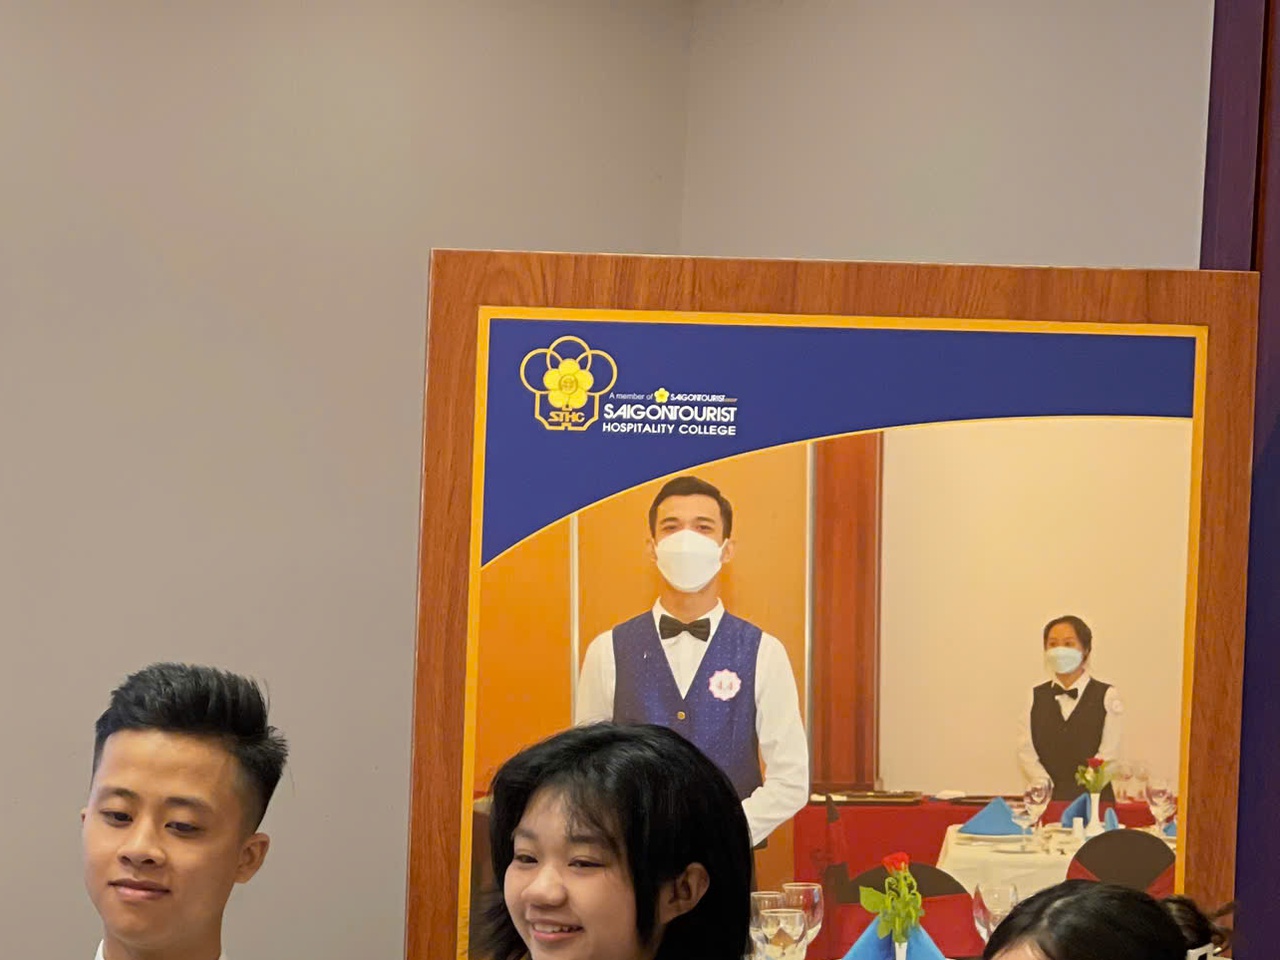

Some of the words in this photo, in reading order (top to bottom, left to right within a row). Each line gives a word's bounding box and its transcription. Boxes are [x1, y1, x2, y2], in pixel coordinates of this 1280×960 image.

[547, 411, 586, 423] STHC
[604, 404, 738, 422] SAIGONTOURIST
[602, 422, 675, 434] HOSPITALITY
[679, 424, 737, 436] COLLEGE
